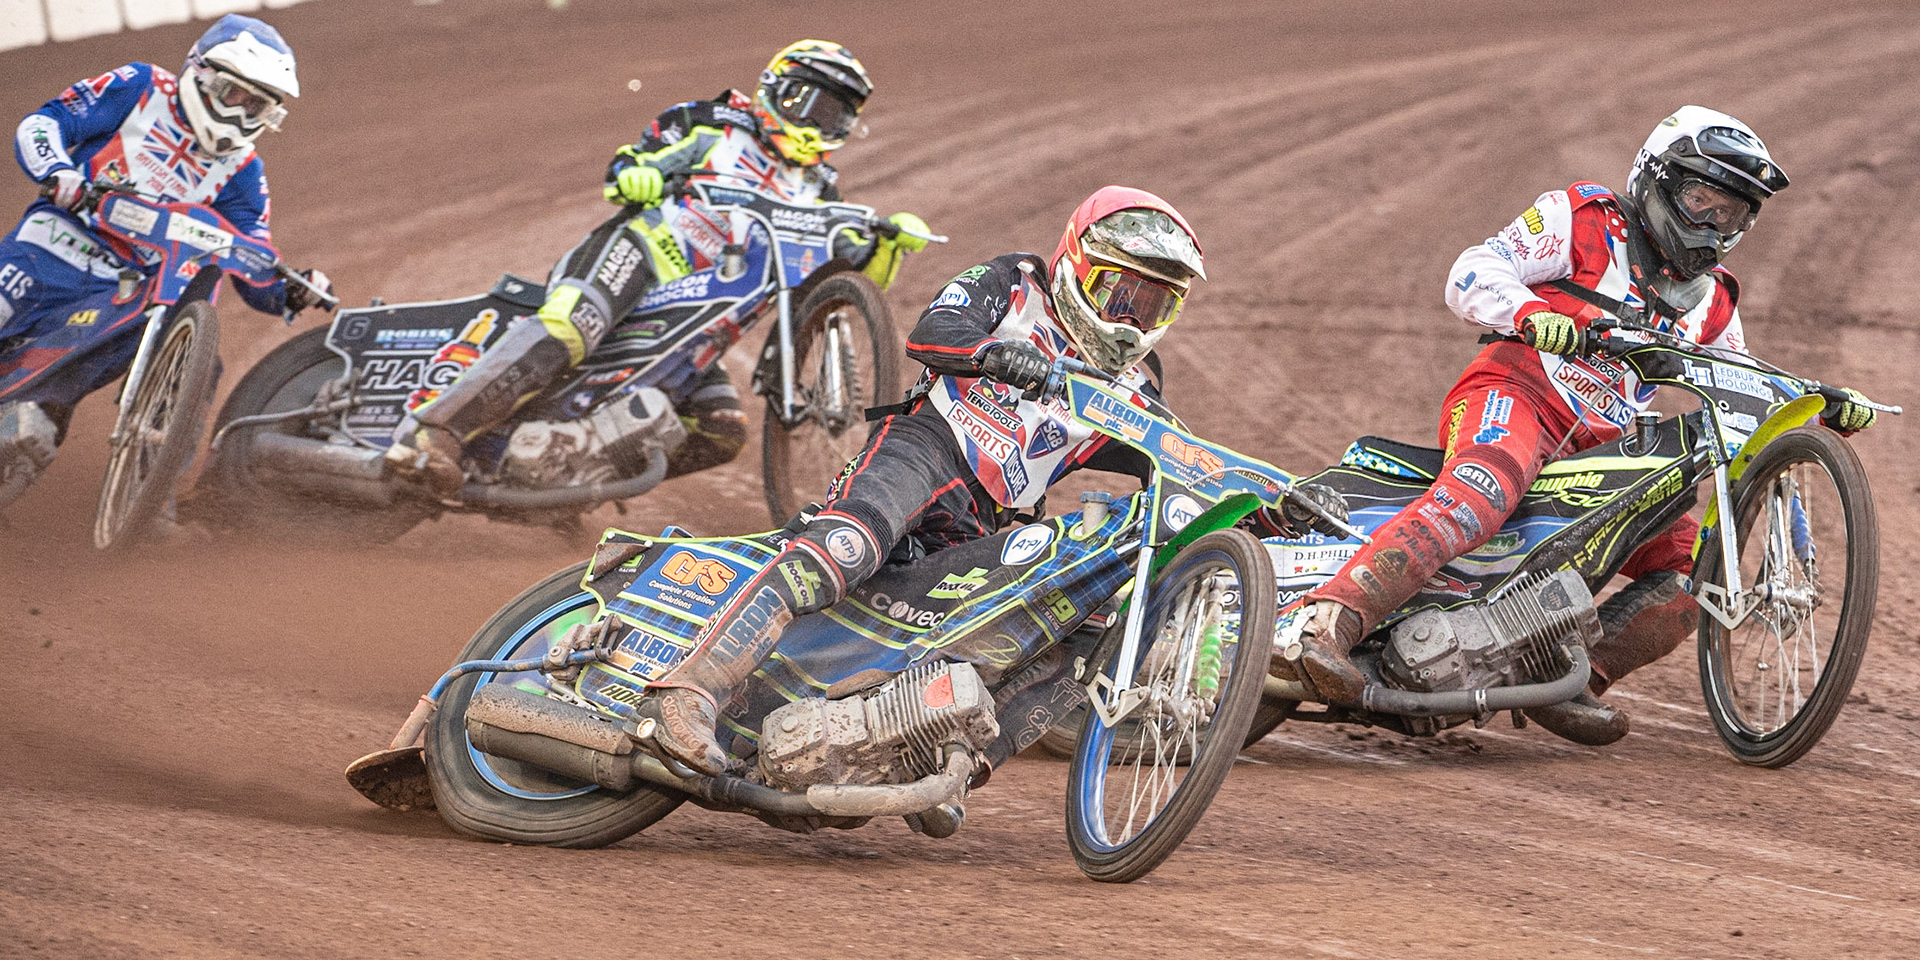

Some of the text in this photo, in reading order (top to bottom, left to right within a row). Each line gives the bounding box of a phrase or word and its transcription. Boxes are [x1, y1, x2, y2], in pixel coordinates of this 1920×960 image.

[343, 316, 371, 340] 6
[1715, 366, 1763, 385] LEDBURY
[1716, 378, 1775, 399] HOLDINGS
[965, 390, 1023, 431] TENGTOOLS
[1090, 391, 1152, 431] ALBON
[1104, 418, 1123, 431] plc
[952, 408, 1012, 461] SPORTS
[1043, 420, 1064, 449] SGB
[1159, 454, 1191, 473] Complete
[1161, 432, 1225, 480] CFS
[1459, 465, 1498, 496] BALL
[836, 533, 857, 559] ATPI
[660, 551, 738, 596] CFS
[785, 562, 811, 607] ROCK OIL
[935, 581, 958, 591] ROCK
[648, 579, 717, 608] Complete Filtration
[656, 591, 693, 611] Solutions
[706, 584, 786, 667] ALBON
[621, 629, 689, 667] ALBON
[630, 660, 653, 677] plc
